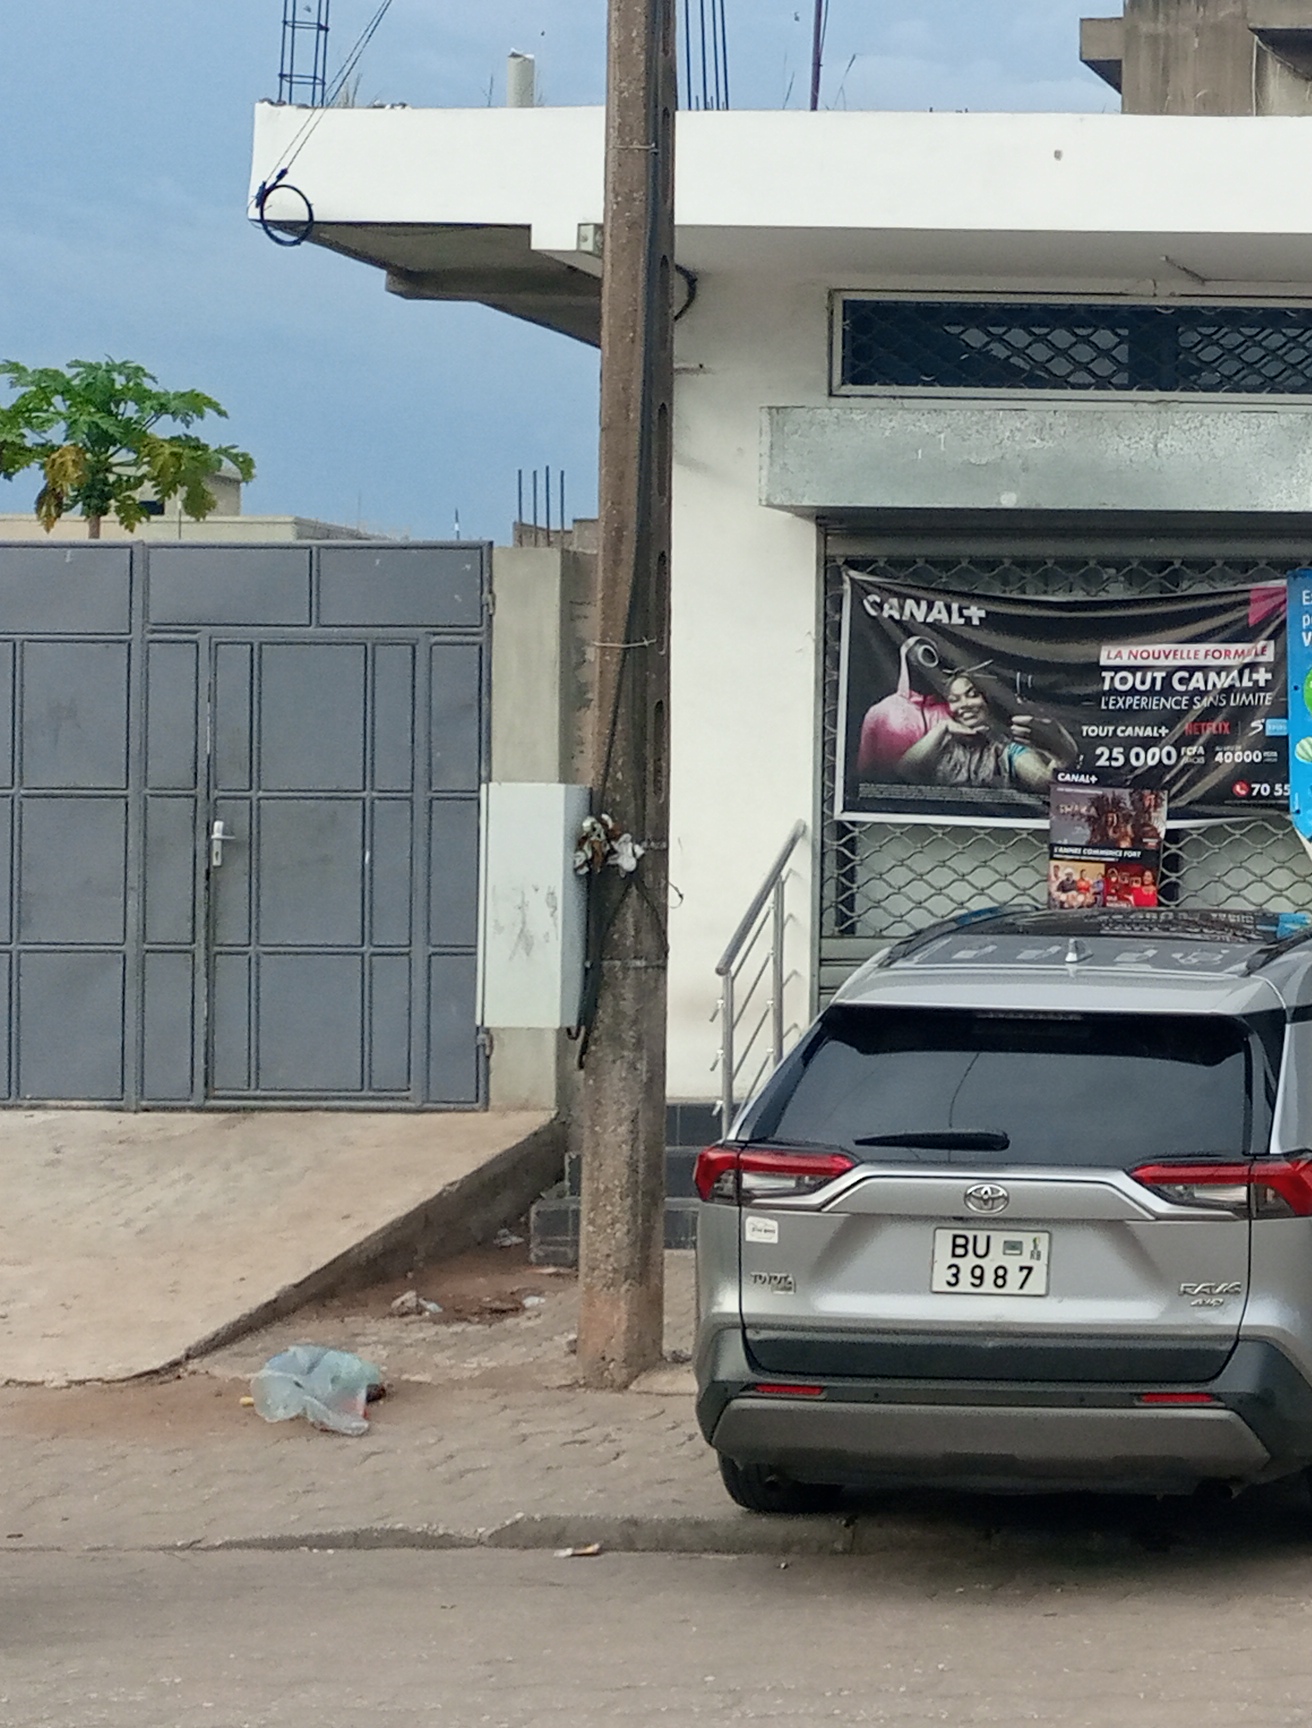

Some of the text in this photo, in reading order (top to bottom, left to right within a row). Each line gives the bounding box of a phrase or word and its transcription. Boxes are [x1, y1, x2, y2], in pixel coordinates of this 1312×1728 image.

[863, 594, 986, 625] CANAL+
[1107, 650, 1123, 660] LA
[1127, 650, 1199, 660] NOUVELLE
[1101, 668, 1272, 691] TOUT CANAL+
[1193, 694, 1226, 709] SANS
[1230, 692, 1273, 706] LIMITE
[1082, 725, 1169, 737] TOUT CANAL+
[1186, 721, 1230, 735] NETFLIX
[1095, 747, 1125, 767] 25
[1130, 746, 1177, 766] 000
[1058, 773, 1098, 784] CANAL+
[1251, 784, 1290, 796] 70 55
[951, 1234, 991, 1259] BU
[946, 1264, 1034, 1290] 3987
[1178, 1282, 1240, 1296] RAV4
